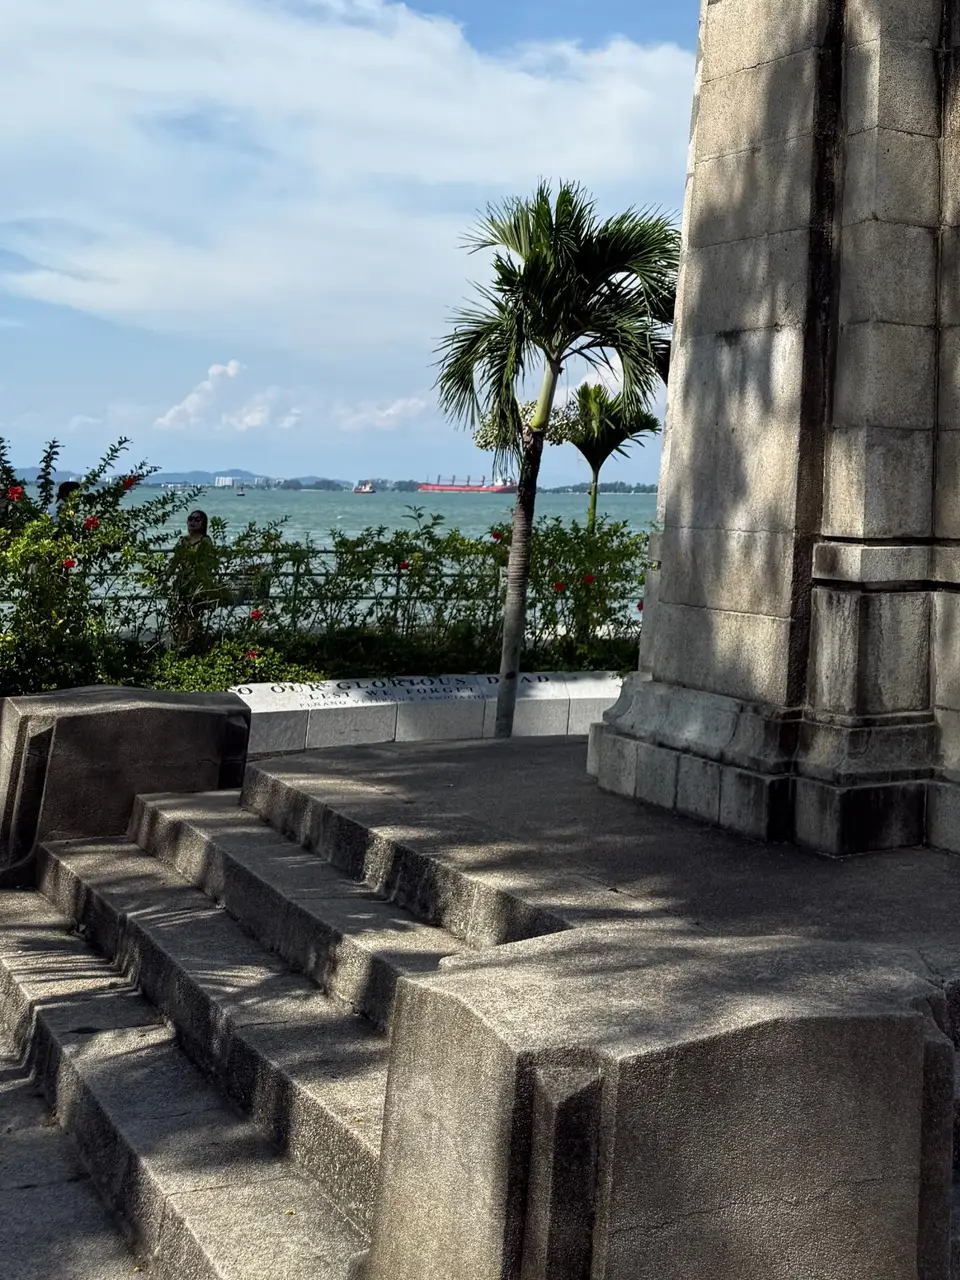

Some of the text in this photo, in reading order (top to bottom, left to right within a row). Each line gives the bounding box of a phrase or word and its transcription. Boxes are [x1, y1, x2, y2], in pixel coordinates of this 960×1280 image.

[336, 677, 467, 690] GLORIOUS
[487, 675, 550, 684] DAD
[309, 691, 352, 700] LEST
[406, 687, 474, 695] FORGET
